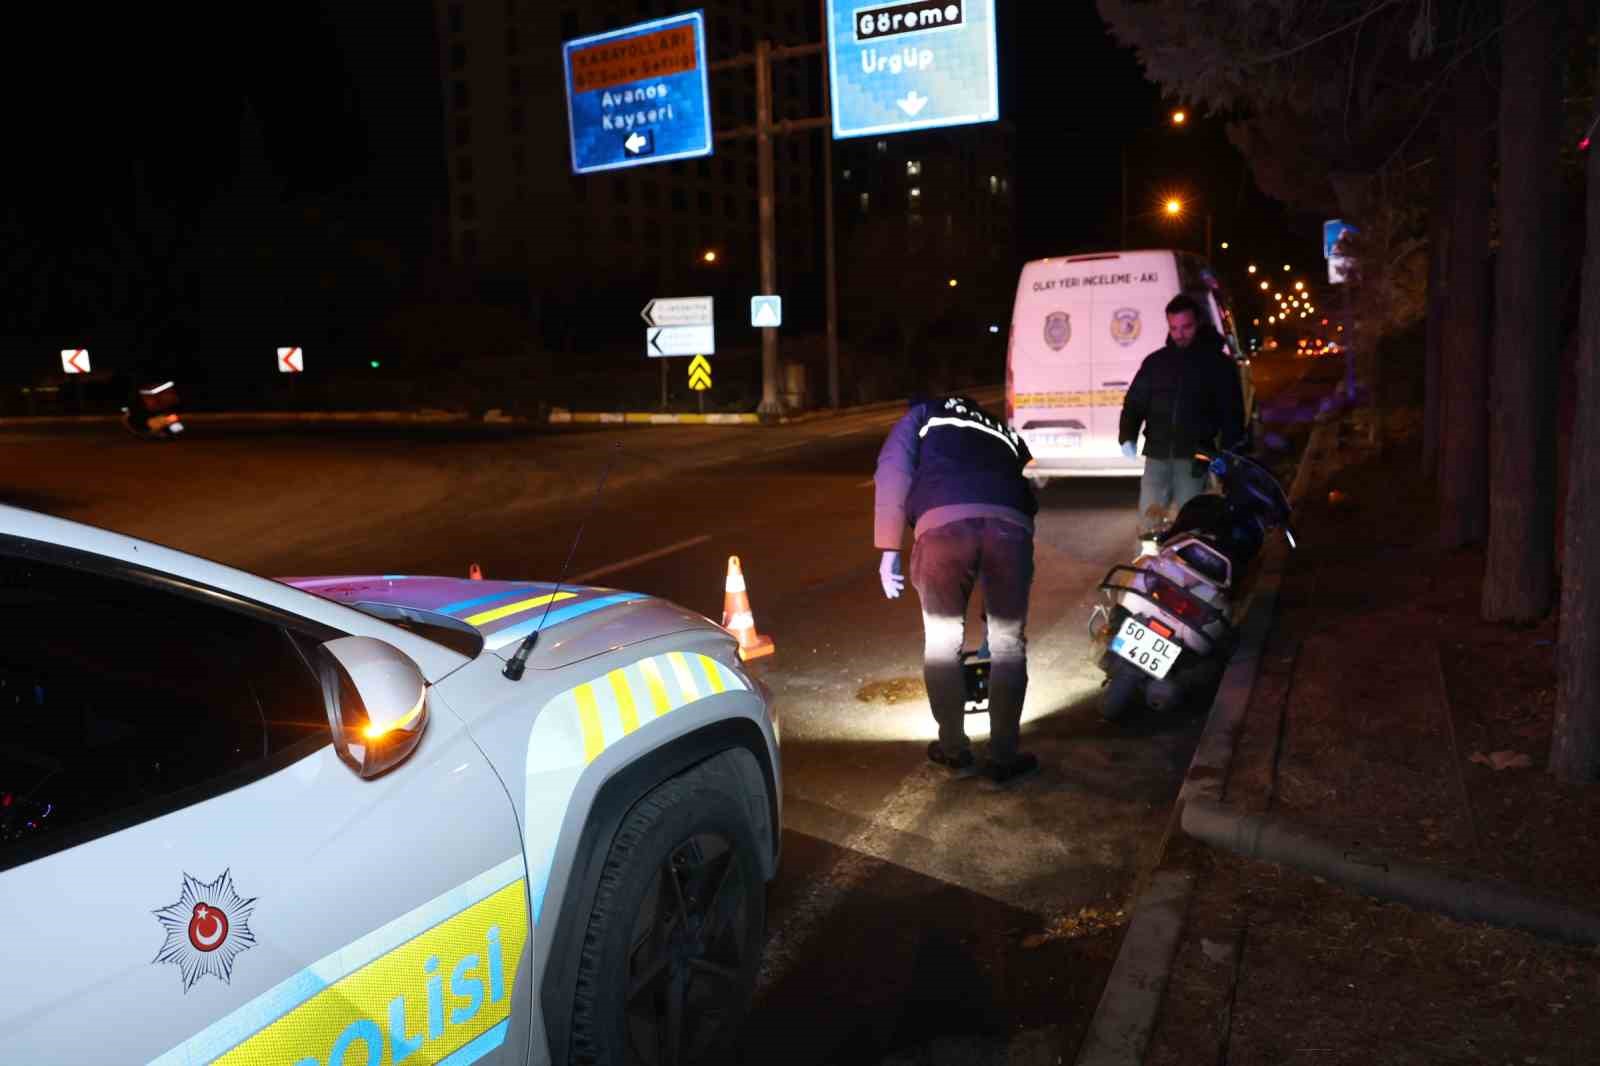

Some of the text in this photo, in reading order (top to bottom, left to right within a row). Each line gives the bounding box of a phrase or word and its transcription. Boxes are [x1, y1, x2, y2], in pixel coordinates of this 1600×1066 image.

[859, 4, 959, 35] Göreme
[602, 84, 667, 107] Avanos
[602, 104, 673, 130] Kayseri
[1033, 281, 1056, 292] OLAY
[1126, 622, 1171, 660] 50 DL
[1128, 646, 1161, 671] 405
[294, 924, 505, 1066] OLİSİ
